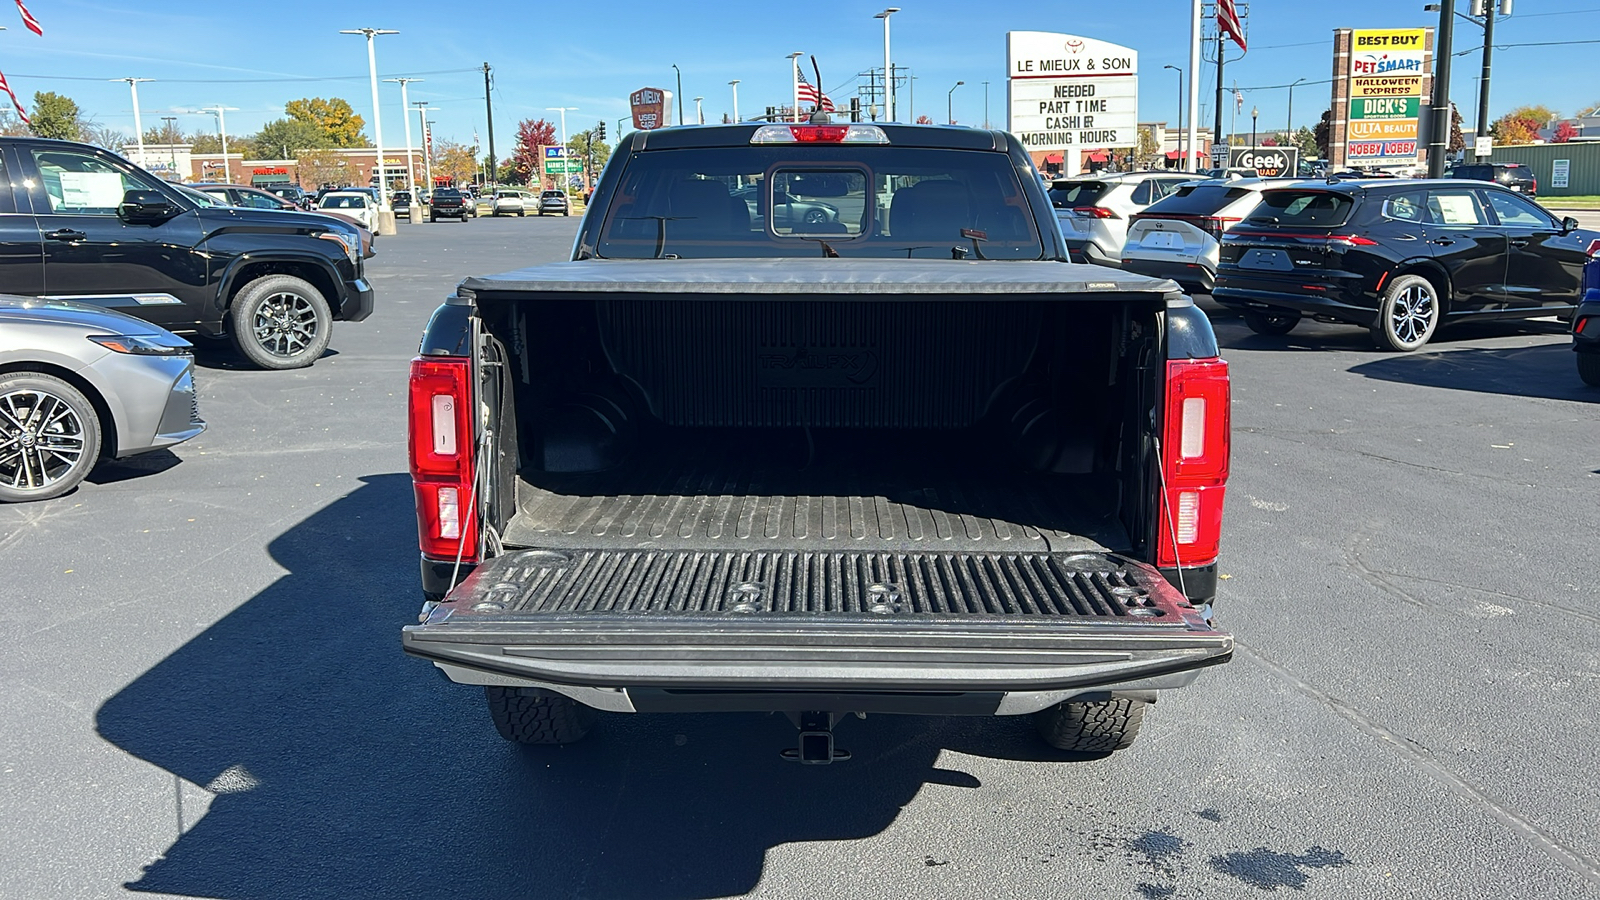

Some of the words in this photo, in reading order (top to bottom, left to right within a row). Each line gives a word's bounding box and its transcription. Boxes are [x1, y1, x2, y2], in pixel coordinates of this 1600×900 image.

[1358, 36, 1389, 45] BEST
[1391, 35, 1420, 45] BUY
[1017, 60, 1033, 72] LE
[1040, 59, 1080, 71] MIEUX
[1086, 59, 1095, 70] &
[1102, 58, 1131, 70] SON
[1355, 78, 1419, 86] HALLOWEEN
[1054, 84, 1095, 98] NEEDED
[1363, 87, 1411, 95] EXPRESS
[632, 93, 640, 105] LE
[1039, 101, 1070, 114] PART
[1075, 100, 1106, 113] TIME
[1363, 98, 1407, 114] DICK'S
[638, 113, 657, 122] USED
[1046, 115, 1094, 130] CASHIER
[1354, 122, 1382, 134] ULTA
[1384, 124, 1417, 133] BEAUTY
[1021, 131, 1072, 145] MORNING
[1080, 130, 1117, 143] HOURS
[1349, 143, 1382, 155] HOBBY
[1384, 142, 1415, 154] LOBBY
[1242, 152, 1284, 168] Geek
[1257, 168, 1278, 176] UAD
